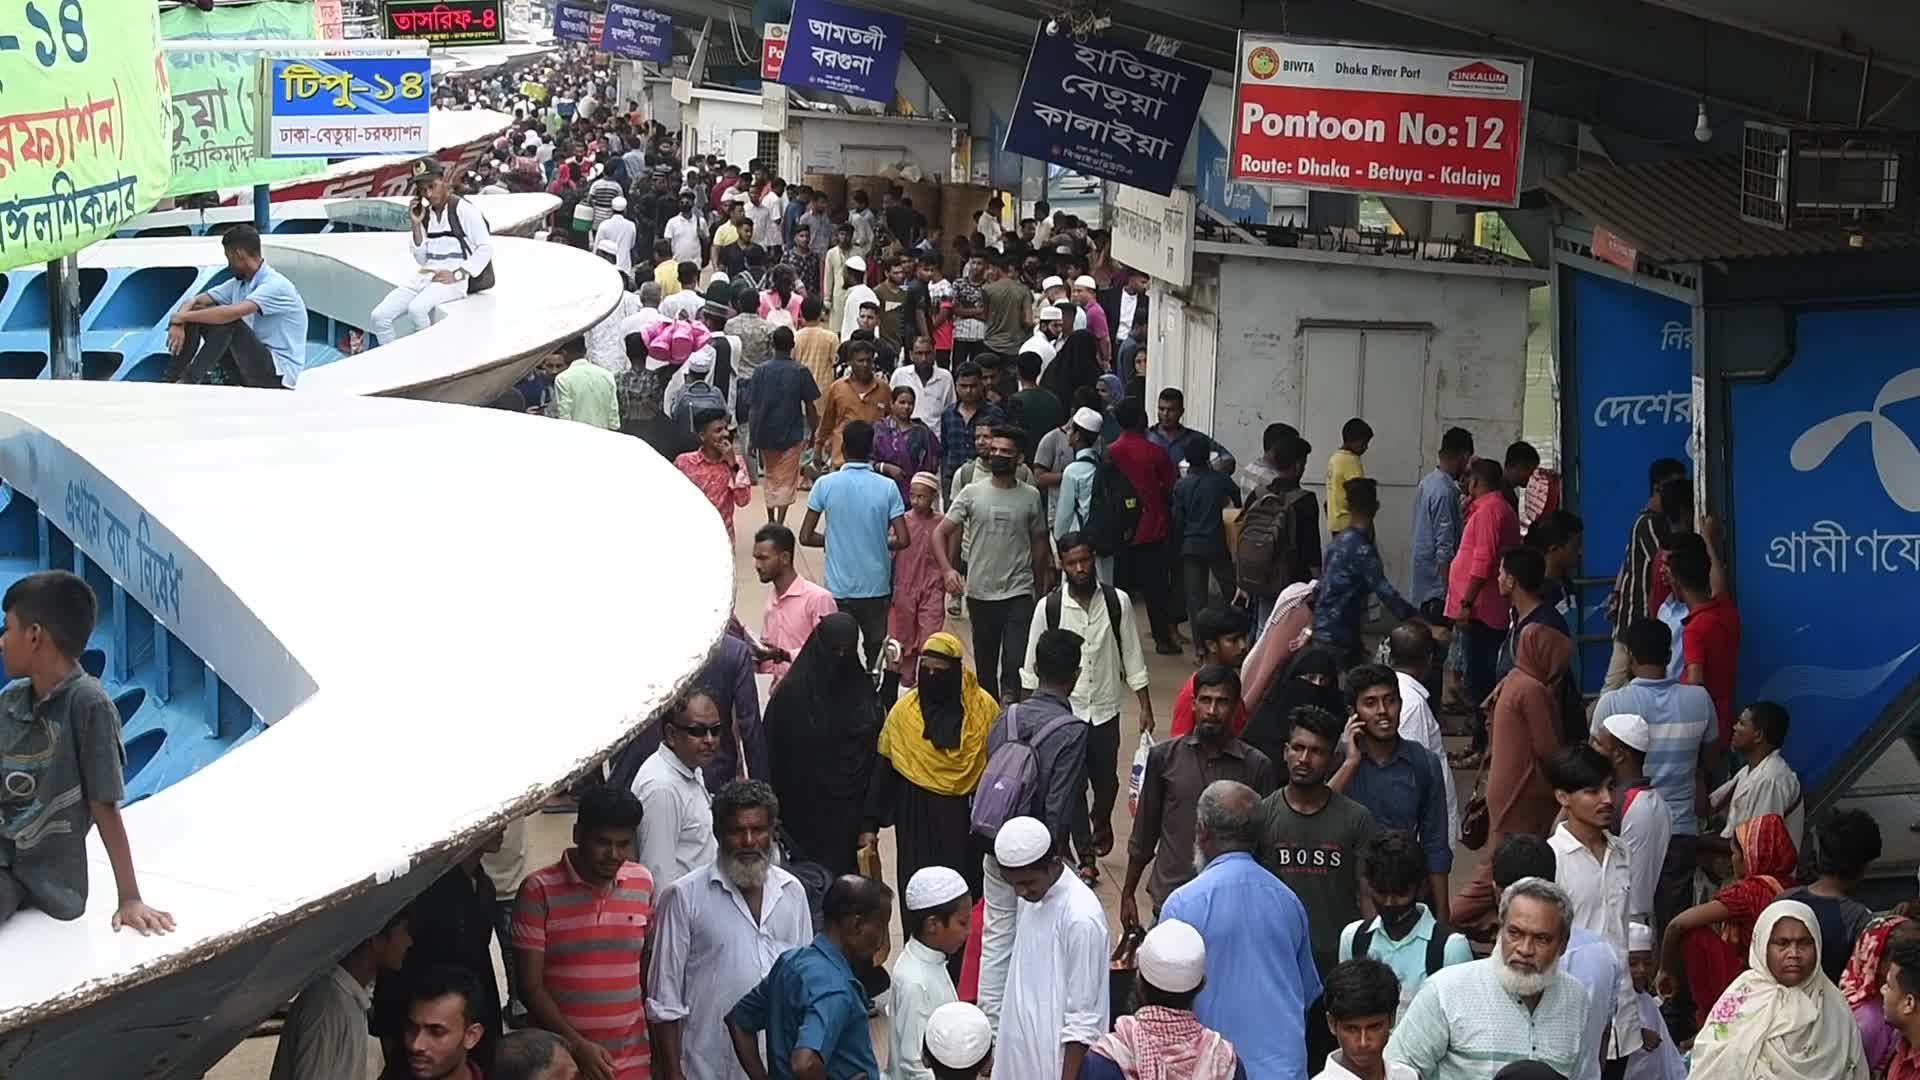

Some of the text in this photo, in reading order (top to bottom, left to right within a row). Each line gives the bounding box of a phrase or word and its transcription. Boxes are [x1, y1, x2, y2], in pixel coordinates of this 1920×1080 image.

[392, 4, 496, 32] তাসরিফ-৪
[808, 18, 887, 52] আমতলী
[810, 46, 875, 76] বরগুনা
[1073, 42, 1187, 95] হাতিয়া
[1283, 61, 1421, 79] BIWTA Dhaka River Port
[1451, 71, 1506, 83] ZINKALUM
[279, 63, 425, 110] টিপু-১৪
[1062, 74, 1168, 120] বেতুয়া
[280, 124, 422, 147] ঢাকা-বেতুয়া-চরফ্যাশন
[1032, 101, 1175, 160] কালাইয়া
[1241, 102, 1504, 150] Pontoon No:12
[1241, 154, 1292, 174] Route:
[1298, 157, 1350, 178] Dhaka
[1368, 162, 1423, 183] Betuya
[1440, 167, 1500, 190] Kalaiya
[0, 169, 137, 249] ঙ্গলশিকদার
[1280, 849, 1341, 867] BOSS
